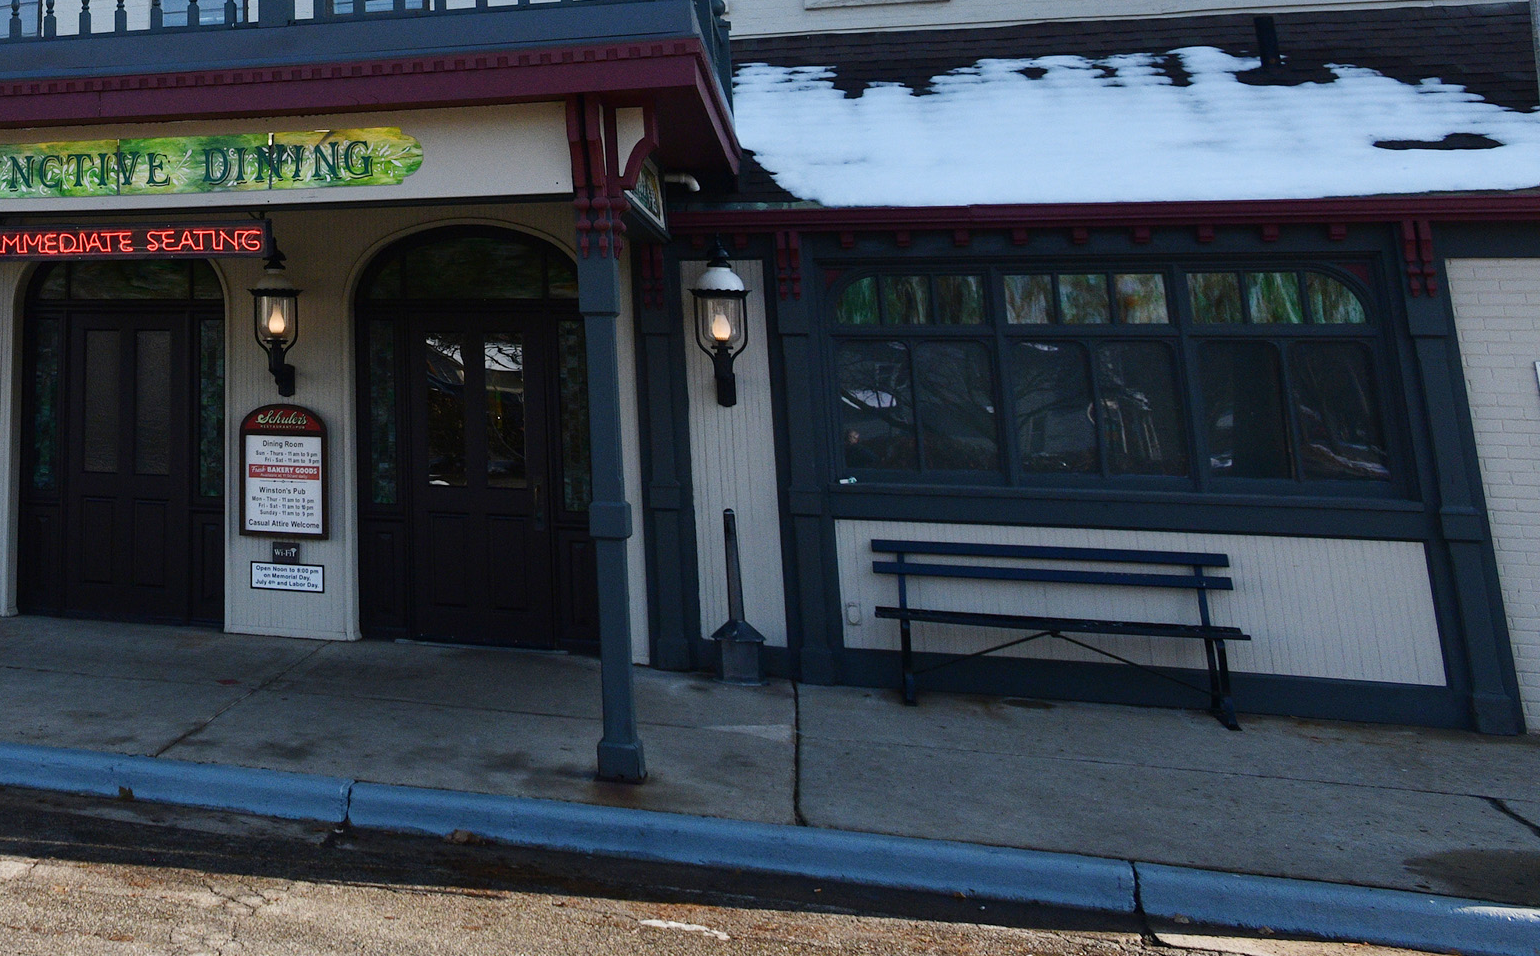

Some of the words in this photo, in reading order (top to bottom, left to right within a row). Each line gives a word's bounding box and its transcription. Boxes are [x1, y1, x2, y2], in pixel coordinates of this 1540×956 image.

[202, 140, 374, 185] DINING
[146, 230, 261, 251] SEATING
[255, 410, 307, 424] Schuler's
[262, 440, 283, 448] Dining
[259, 486, 291, 494] Winston's
[293, 487, 306, 495] Pub
[248, 518, 270, 526] Casual
[290, 521, 320, 529] Welcome
